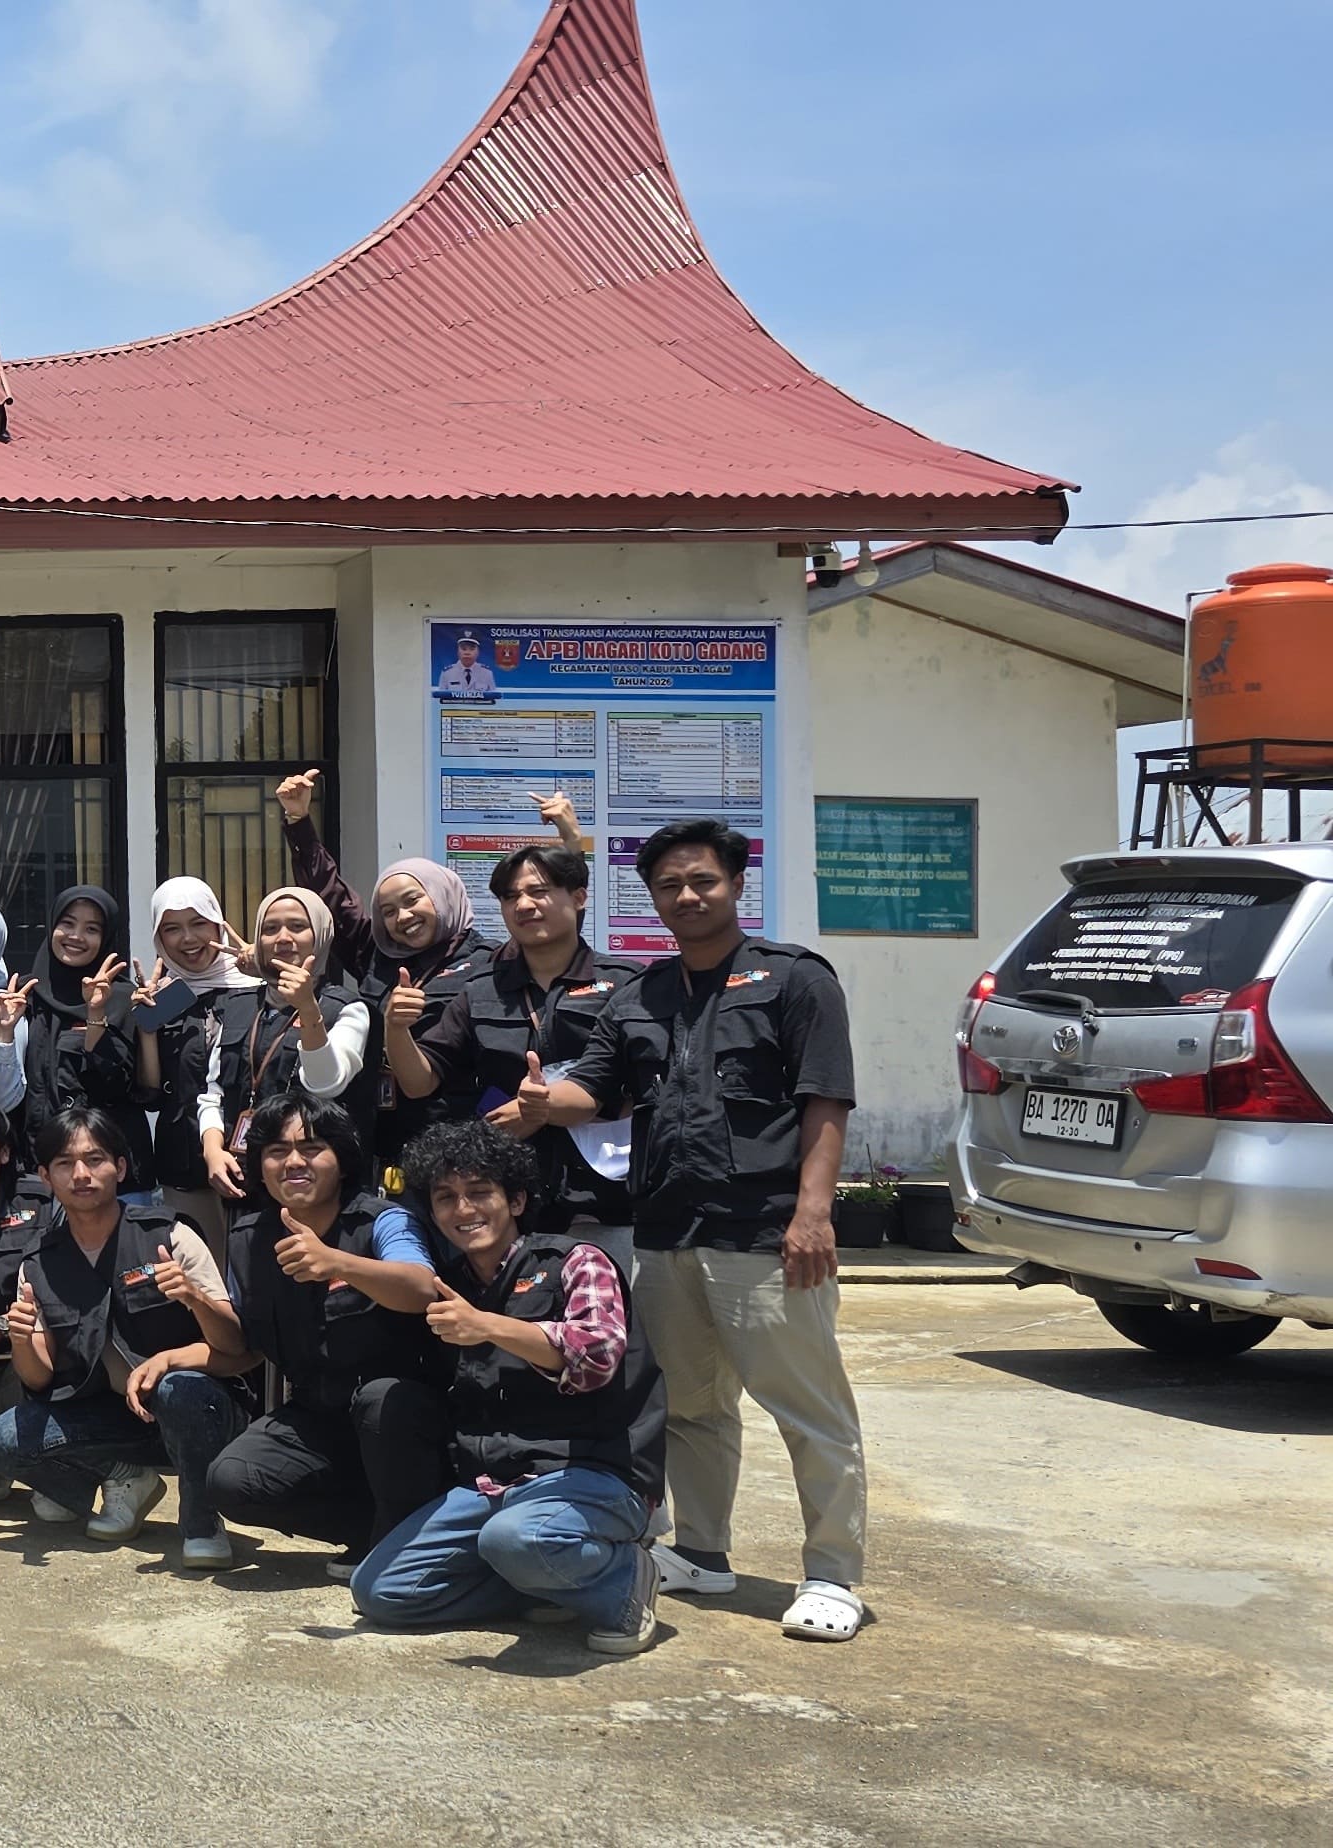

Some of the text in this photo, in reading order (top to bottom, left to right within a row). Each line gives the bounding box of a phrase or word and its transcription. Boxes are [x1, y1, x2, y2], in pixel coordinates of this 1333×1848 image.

[490, 628, 766, 640] SOSIALISASI TRANSPARANSI ANGGARAN PENDAPATAN DAN BELANJA
[525, 641, 766, 662] APB NAGARI KOTO GADANG
[550, 664, 732, 675] KECAMATAN BASO KABUPATEN AGAM
[613, 677, 674, 687] TAHUN 2026
[912, 870, 934, 880] KOTO
[936, 870, 969, 881] GADANG
[857, 886, 901, 897] ANGGARAN
[1148, 892, 1170, 902] DAN
[1168, 892, 1195, 902] ILMU
[1192, 893, 1258, 906] PENDIDIKAN
[1083, 921, 1192, 932] PENDIDIKAN BAHASA INGGRIS
[1078, 934, 1170, 946] PENDIDIKAN MATEMATIKA
[1095, 948, 1127, 958] PROFESI
[1126, 949, 1152, 959] GURU
[1156, 950, 1184, 962] (PPG)
[1026, 1094, 1044, 1119] BA
[1050, 1097, 1087, 1124] 1270
[1056, 1126, 1080, 1137] 12-30
